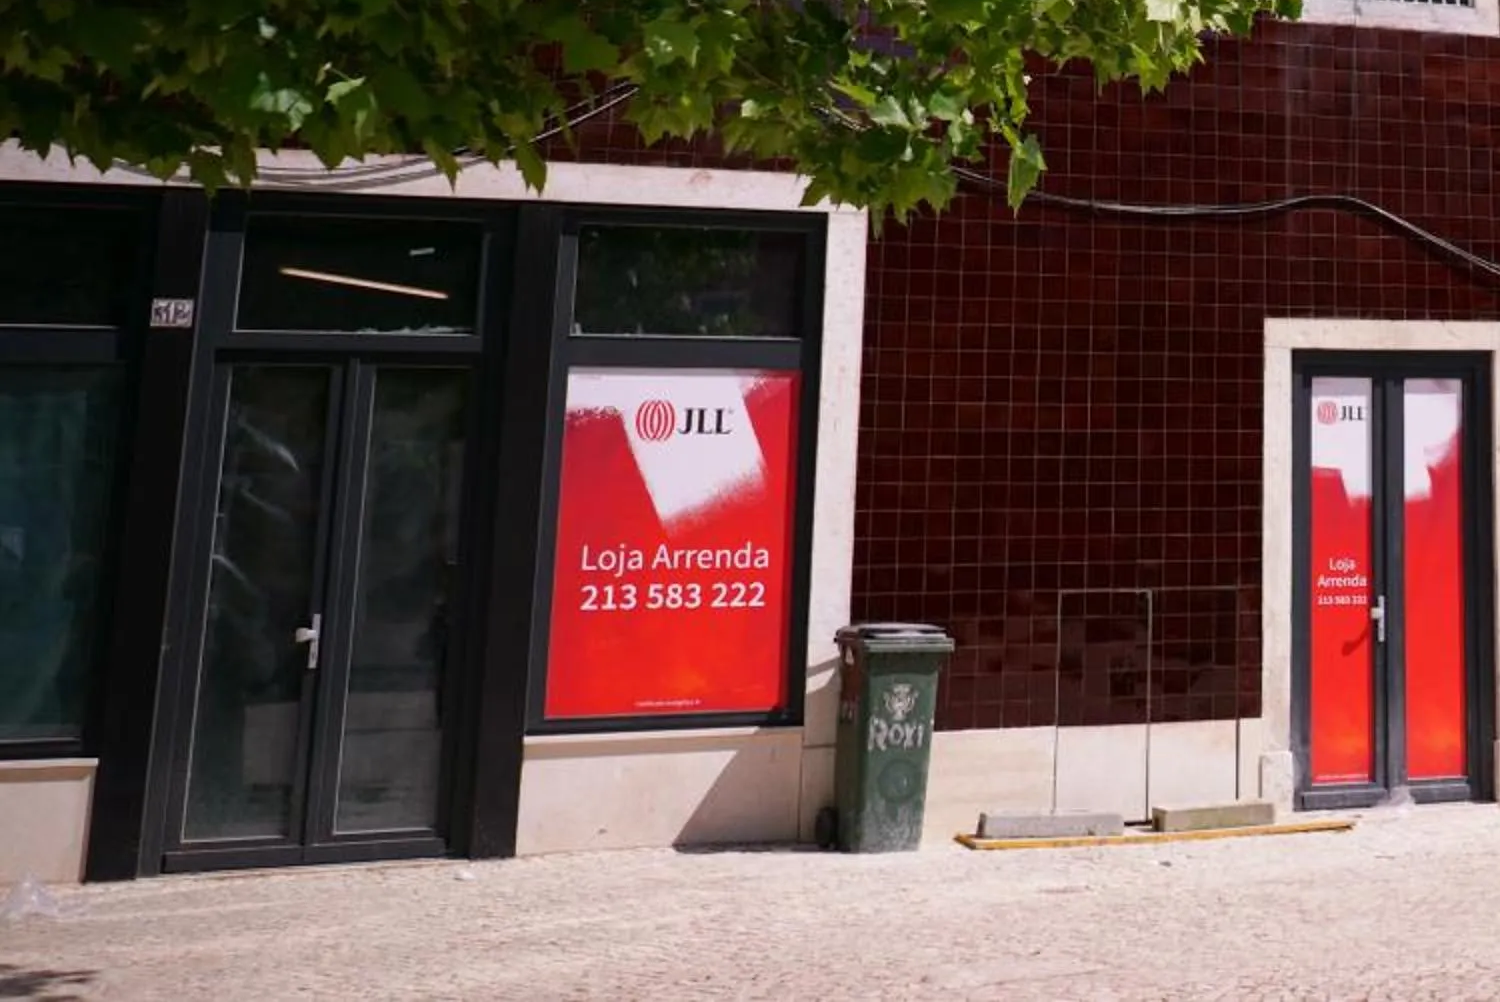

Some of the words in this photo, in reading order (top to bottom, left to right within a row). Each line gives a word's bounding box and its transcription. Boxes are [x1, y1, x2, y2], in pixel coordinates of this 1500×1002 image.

[677, 407, 732, 435] JLL
[581, 543, 643, 578] Loja
[651, 541, 769, 570] Arrenda
[1328, 557, 1356, 574] Loja
[1317, 573, 1367, 588] Arrenda
[579, 584, 638, 611] 213
[645, 582, 702, 609] 583
[711, 580, 766, 607] 222
